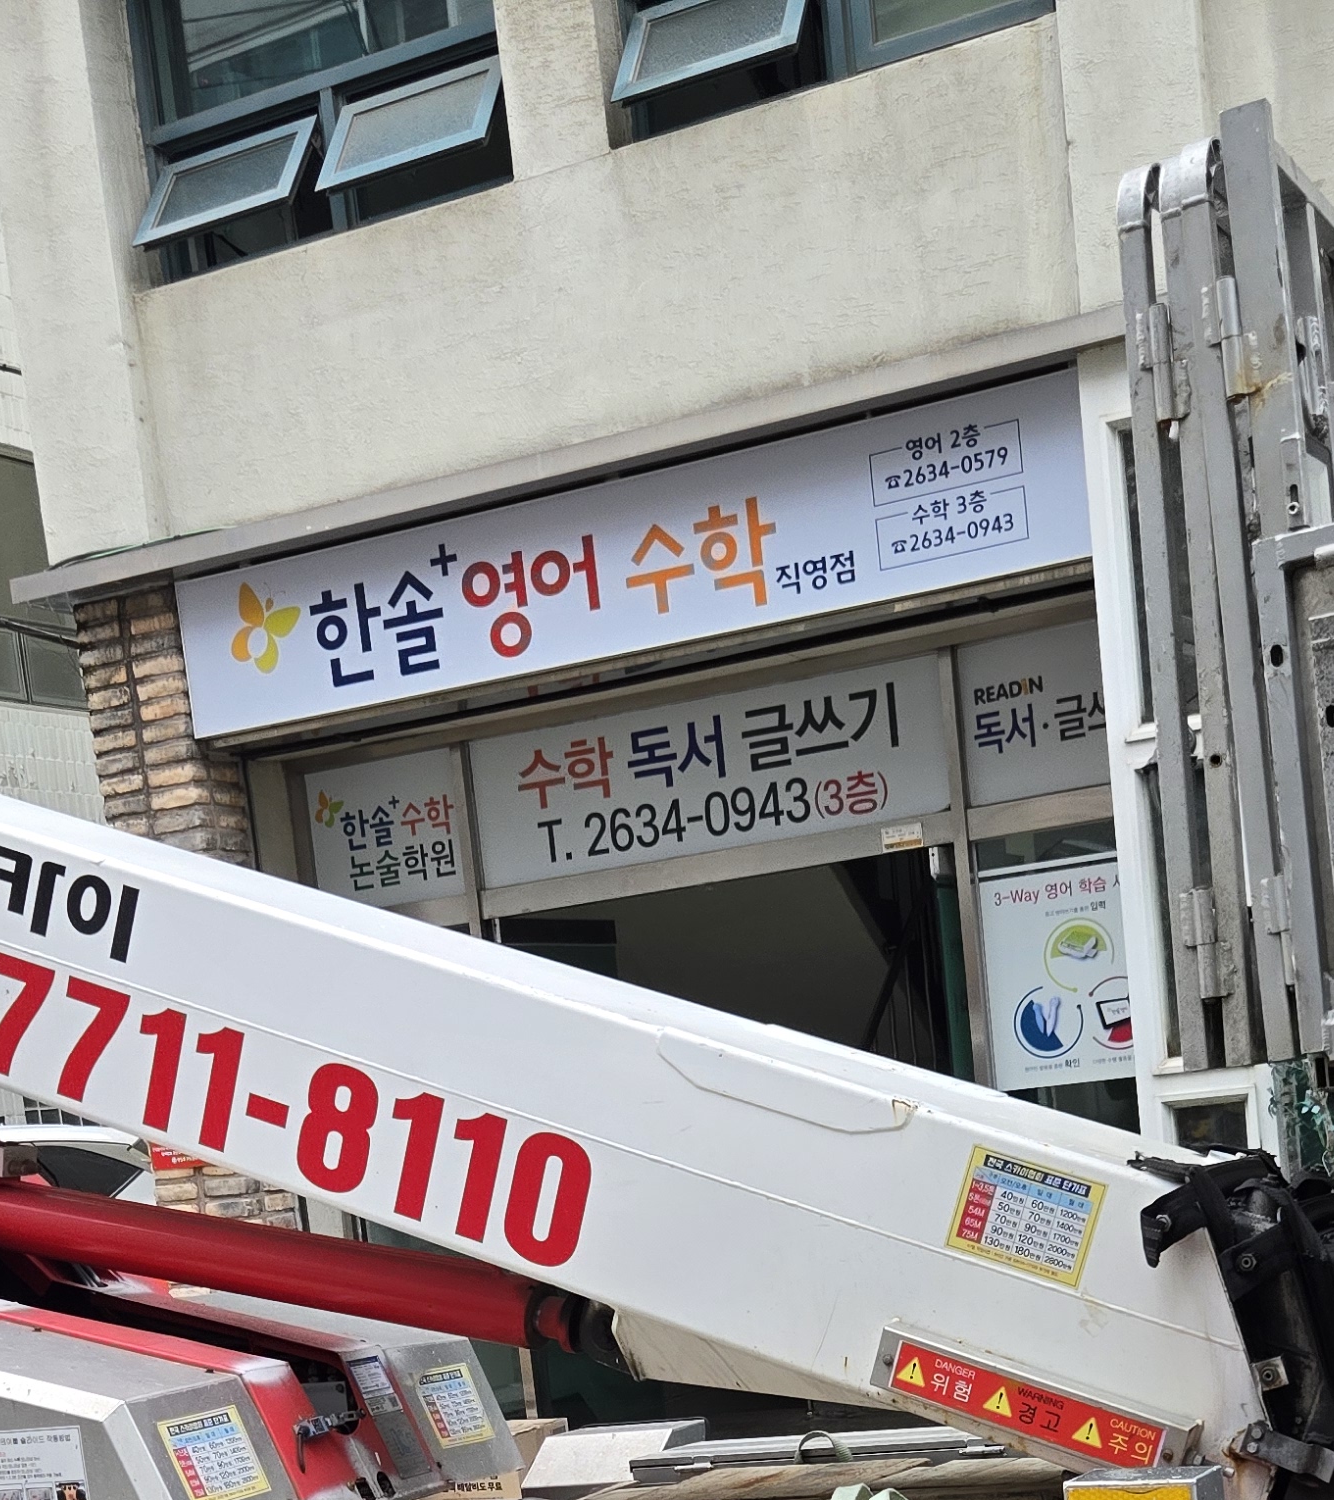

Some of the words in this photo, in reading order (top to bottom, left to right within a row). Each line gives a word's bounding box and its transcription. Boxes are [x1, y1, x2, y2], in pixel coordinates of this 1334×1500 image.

[905, 430, 943, 461] 영어
[949, 423, 982, 453] 2층
[903, 446, 1009, 487] 2634-0579
[912, 497, 950, 524] 수학
[956, 488, 988, 514] 3층
[910, 512, 1014, 553] 2634-0943
[462, 535, 601, 658] 영어
[625, 497, 777, 615] 수학
[776, 550, 857, 595] 직영점
[517, 740, 613, 809] 수학
[628, 713, 725, 788] 독서
[742, 682, 902, 771] 글쓰기
[400, 794, 454, 836] 수학
[537, 818, 574, 864] T.
[349, 839, 457, 892] 논술학원
[993, 886, 1040, 907] 3-Way
[1045, 879, 1073, 901] 영어
[1079, 876, 1107, 895] 학습
[934, 1358, 976, 1381] DANGER
[1017, 1386, 1065, 1411] WARNING
[1109, 1418, 1157, 1441] CAUTION
